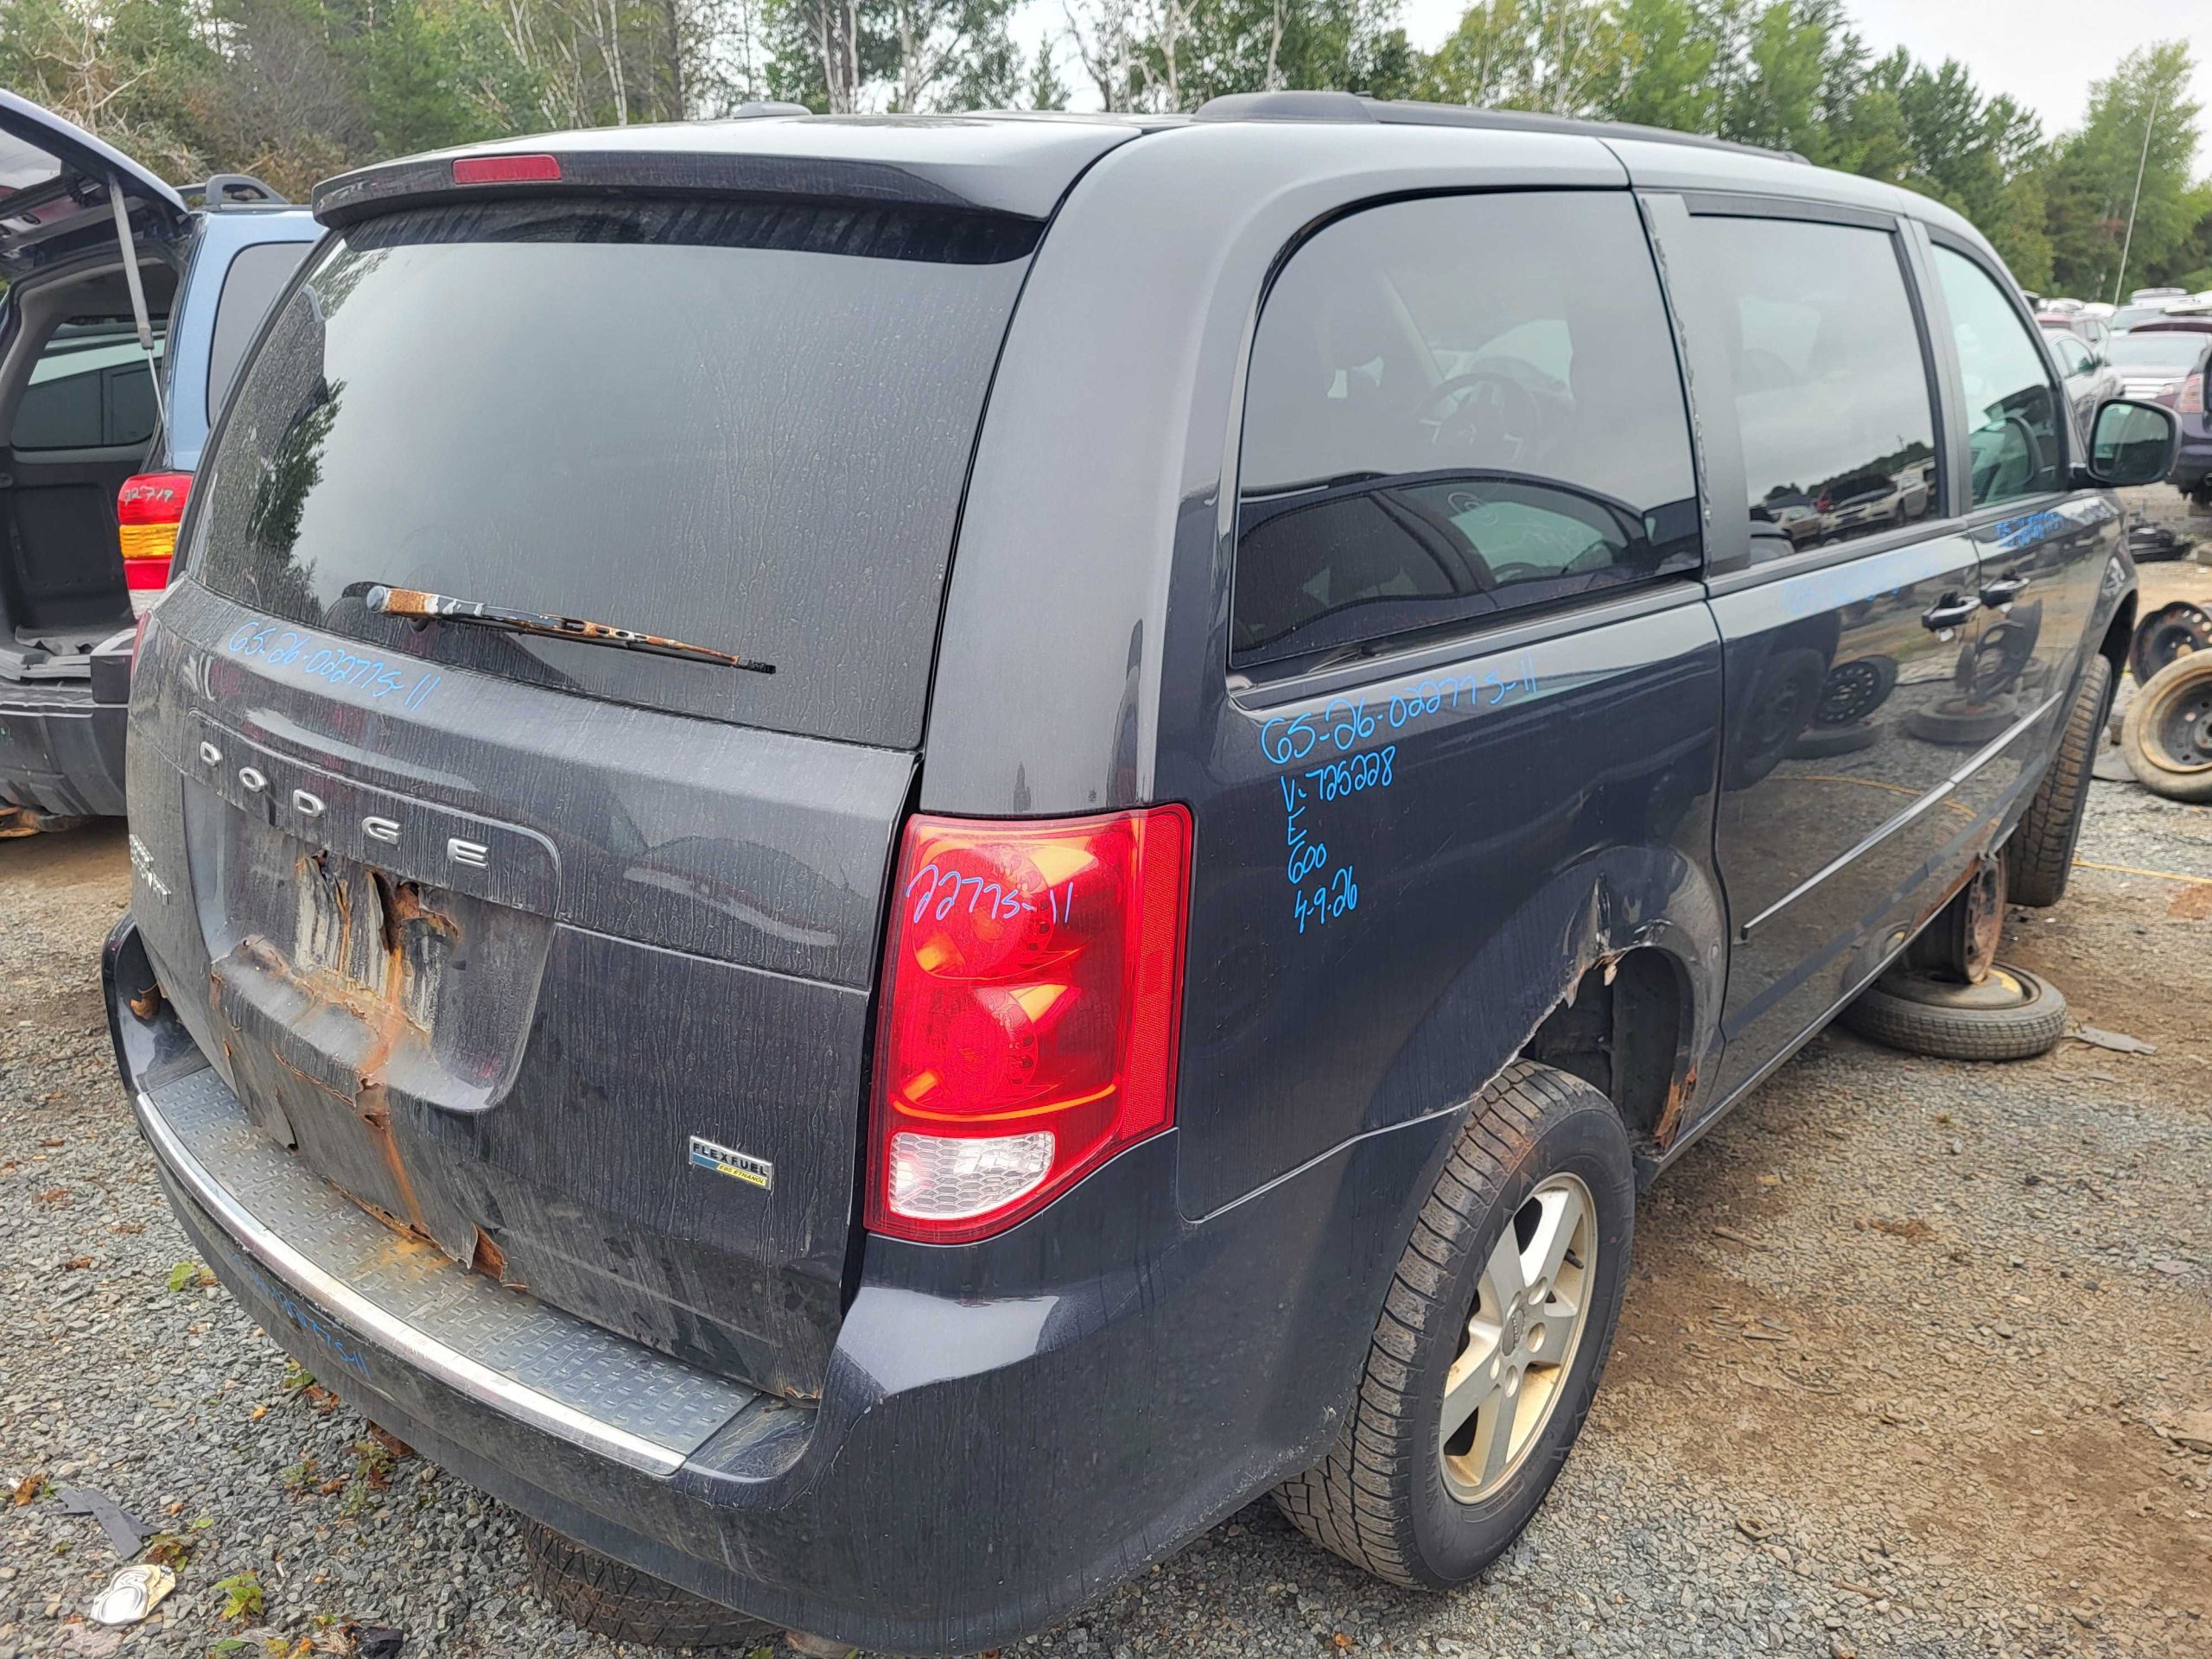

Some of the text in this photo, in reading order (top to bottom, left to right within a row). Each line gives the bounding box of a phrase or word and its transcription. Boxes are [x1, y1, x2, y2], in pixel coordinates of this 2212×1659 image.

[199, 741, 490, 868] DODGE
[1287, 840, 1327, 884] 600
[693, 1142, 767, 1177] FLEXFUEL
[718, 1164, 765, 1185] E85 ETHANOL
